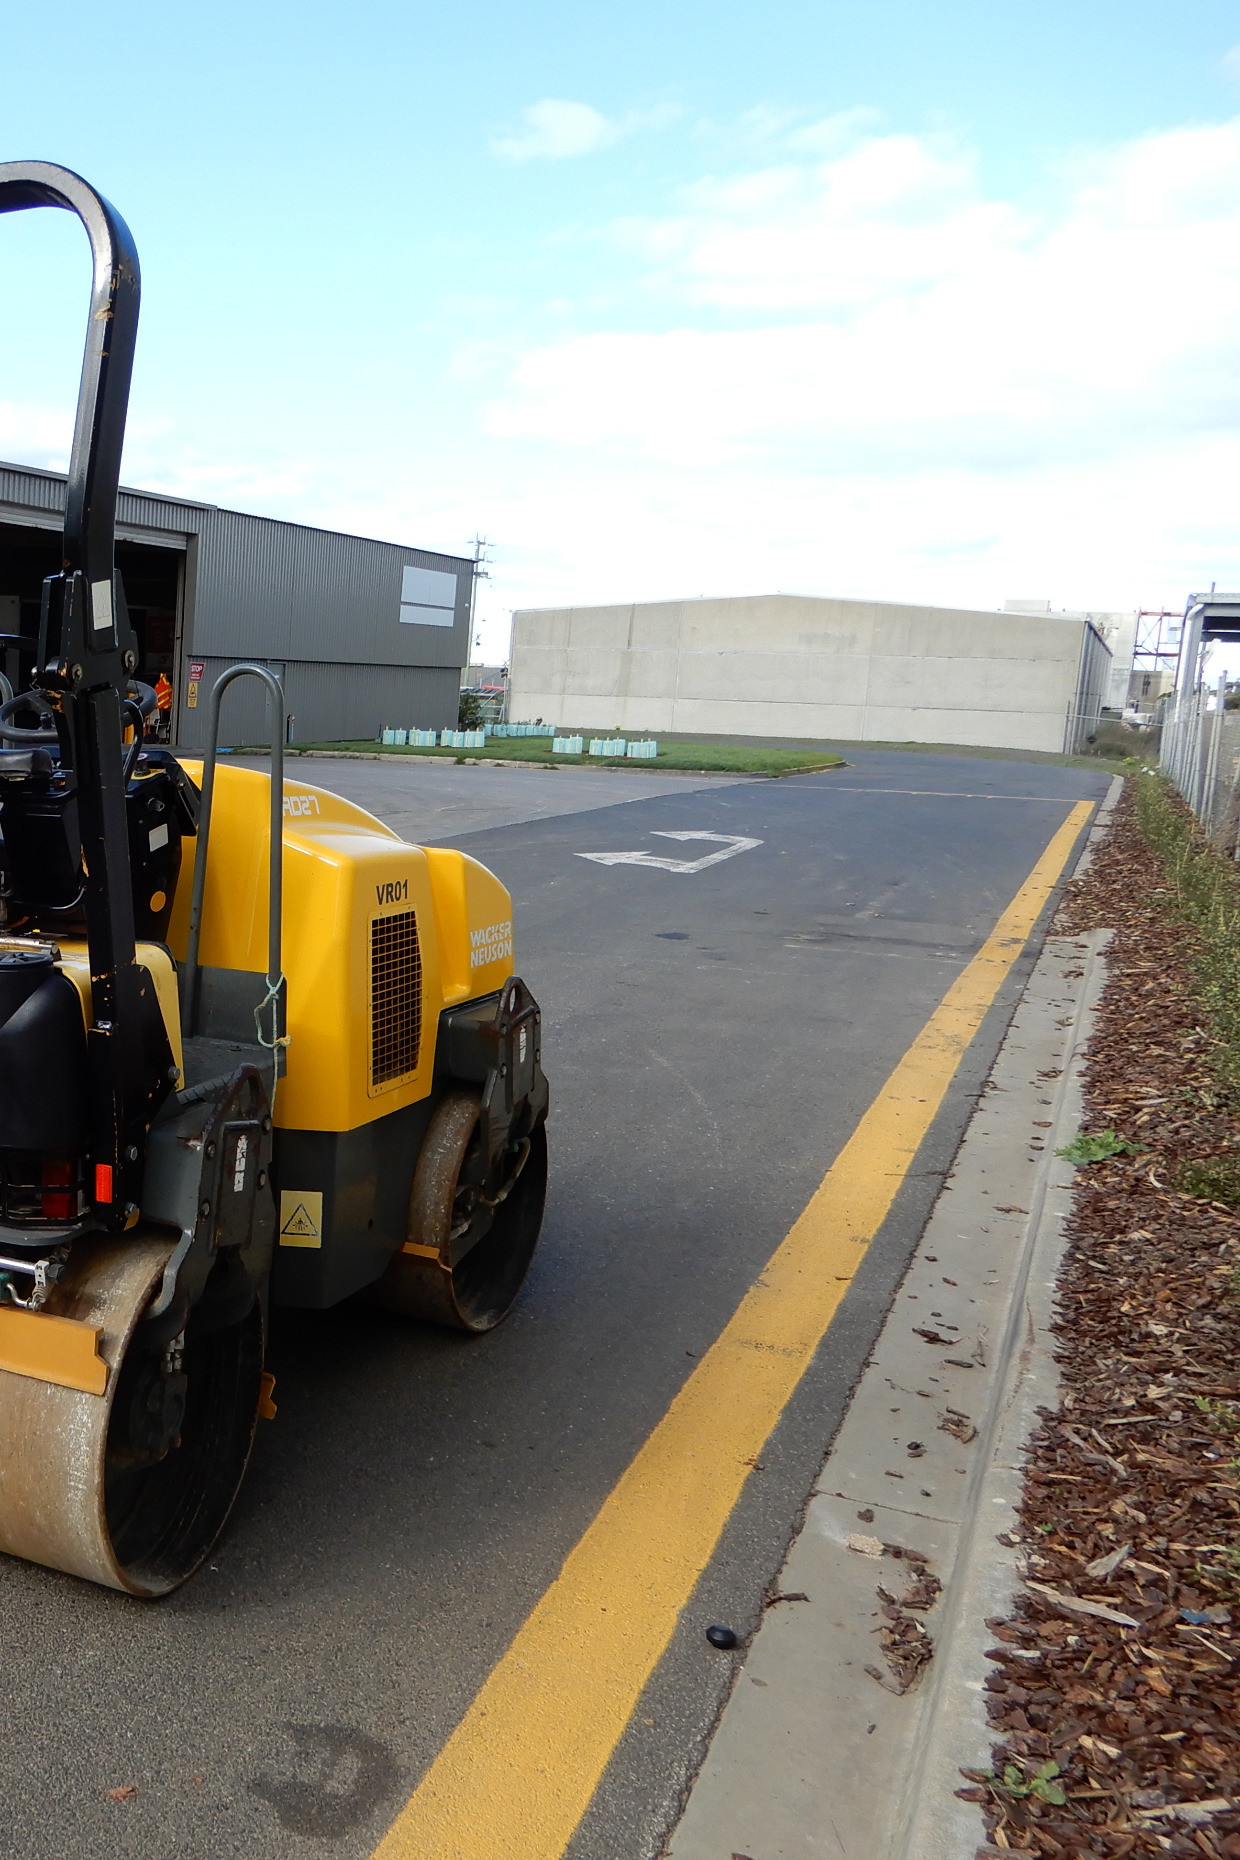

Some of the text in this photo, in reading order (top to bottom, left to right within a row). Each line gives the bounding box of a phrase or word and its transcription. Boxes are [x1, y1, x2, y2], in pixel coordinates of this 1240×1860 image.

[376, 879, 409, 905] VR01
[470, 921, 512, 948] WACKER
[470, 939, 512, 968] NEUSON
